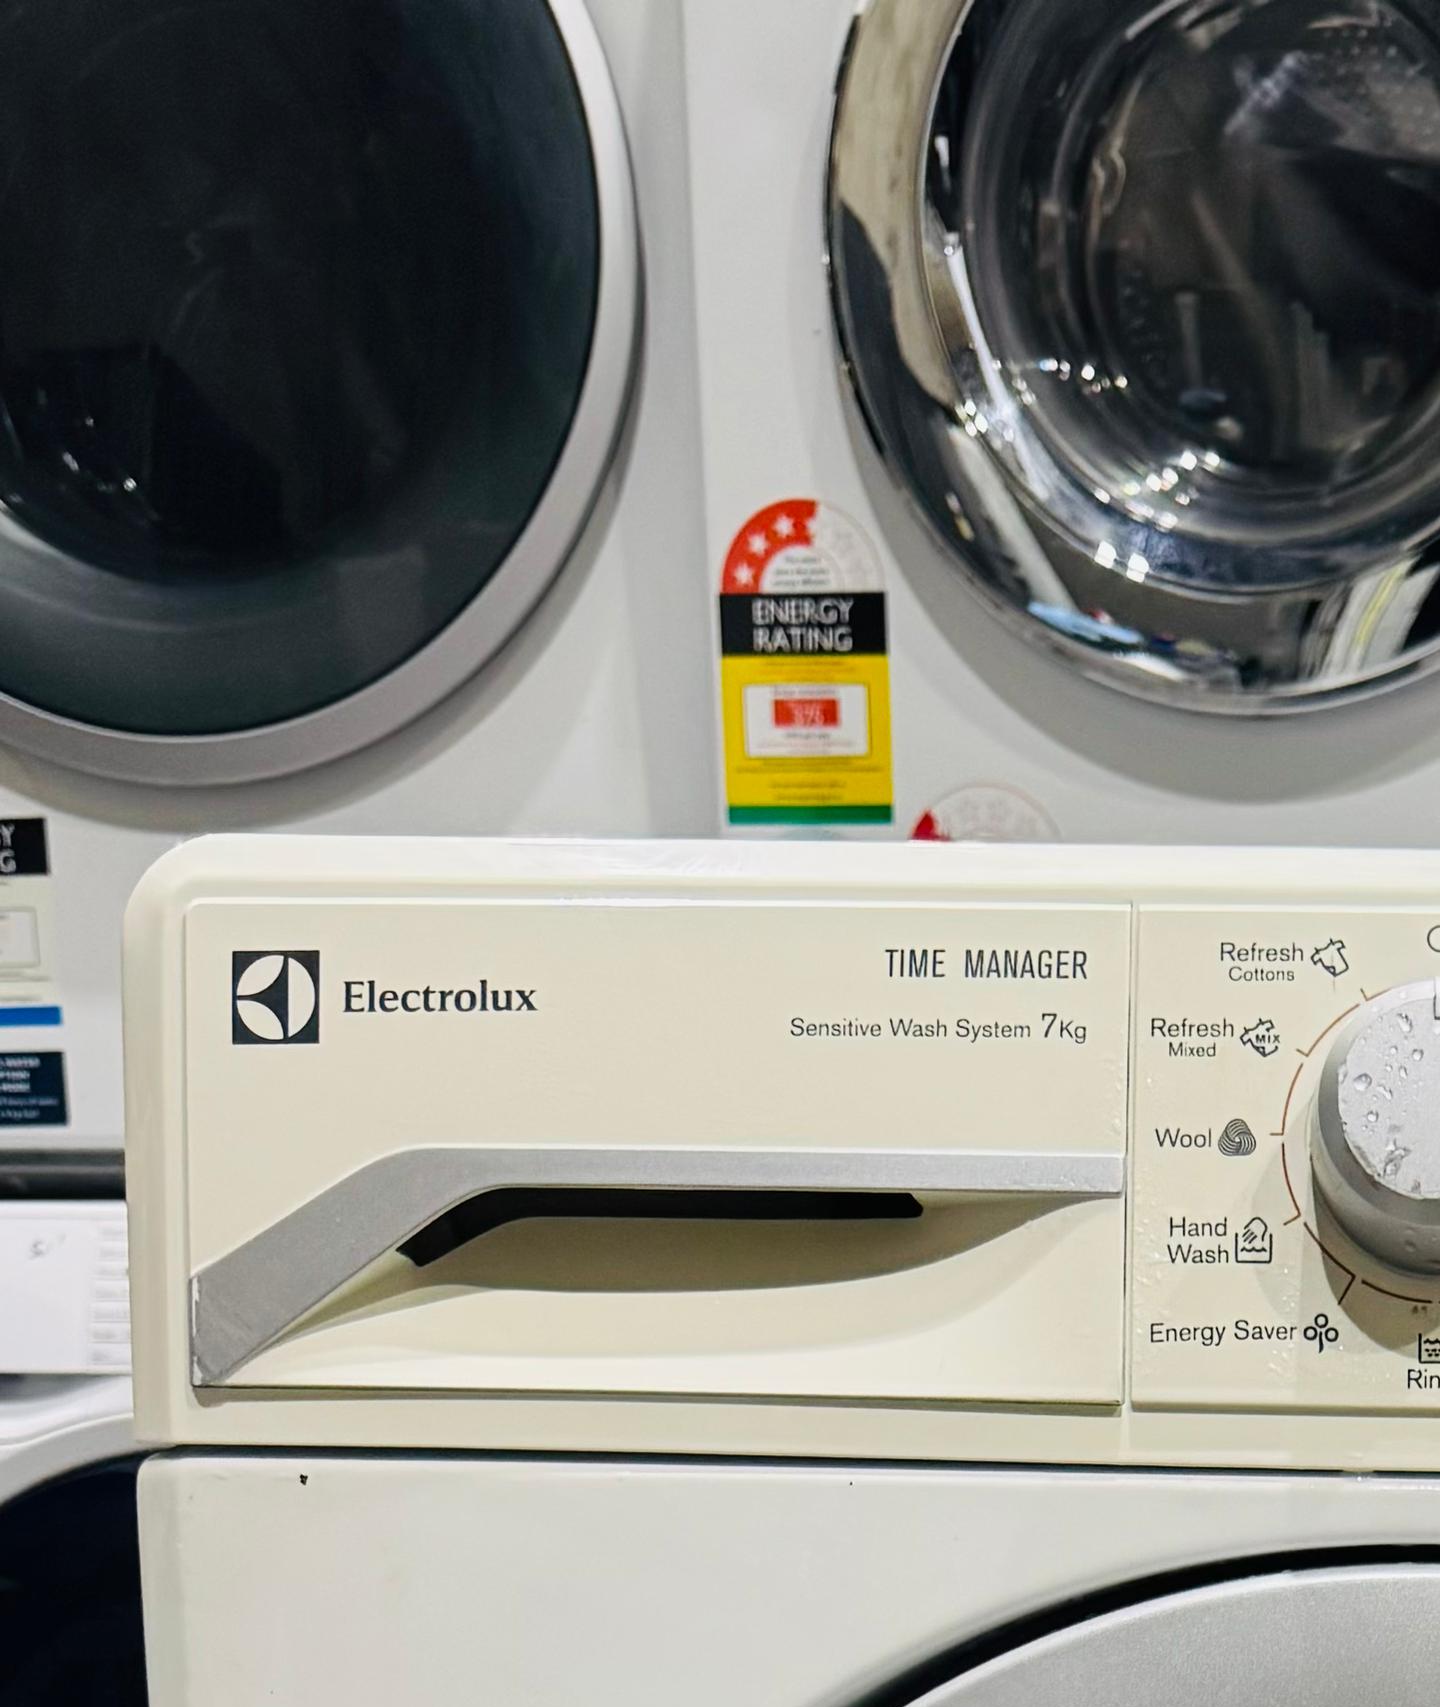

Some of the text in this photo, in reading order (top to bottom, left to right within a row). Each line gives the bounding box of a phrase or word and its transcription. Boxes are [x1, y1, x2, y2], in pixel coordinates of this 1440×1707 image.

[751, 598, 854, 625] ENERGY
[752, 626, 854, 652] RATING
[1220, 942, 1304, 962] Refresh
[884, 949, 1088, 980] TIME MANAGER
[1228, 967, 1295, 982] Cottons
[343, 979, 538, 1013] Electrolux
[790, 1017, 882, 1038] Sensitive
[889, 1018, 947, 1039] Wash
[955, 1019, 1031, 1043] System
[1151, 1018, 1234, 1039] Refresh
[1168, 1042, 1216, 1057] Mixed
[1155, 1128, 1212, 1148] Wool
[1169, 1216, 1228, 1238] Hand
[1167, 1244, 1229, 1264] Wash
[1150, 1320, 1297, 1346] Energy Saver
